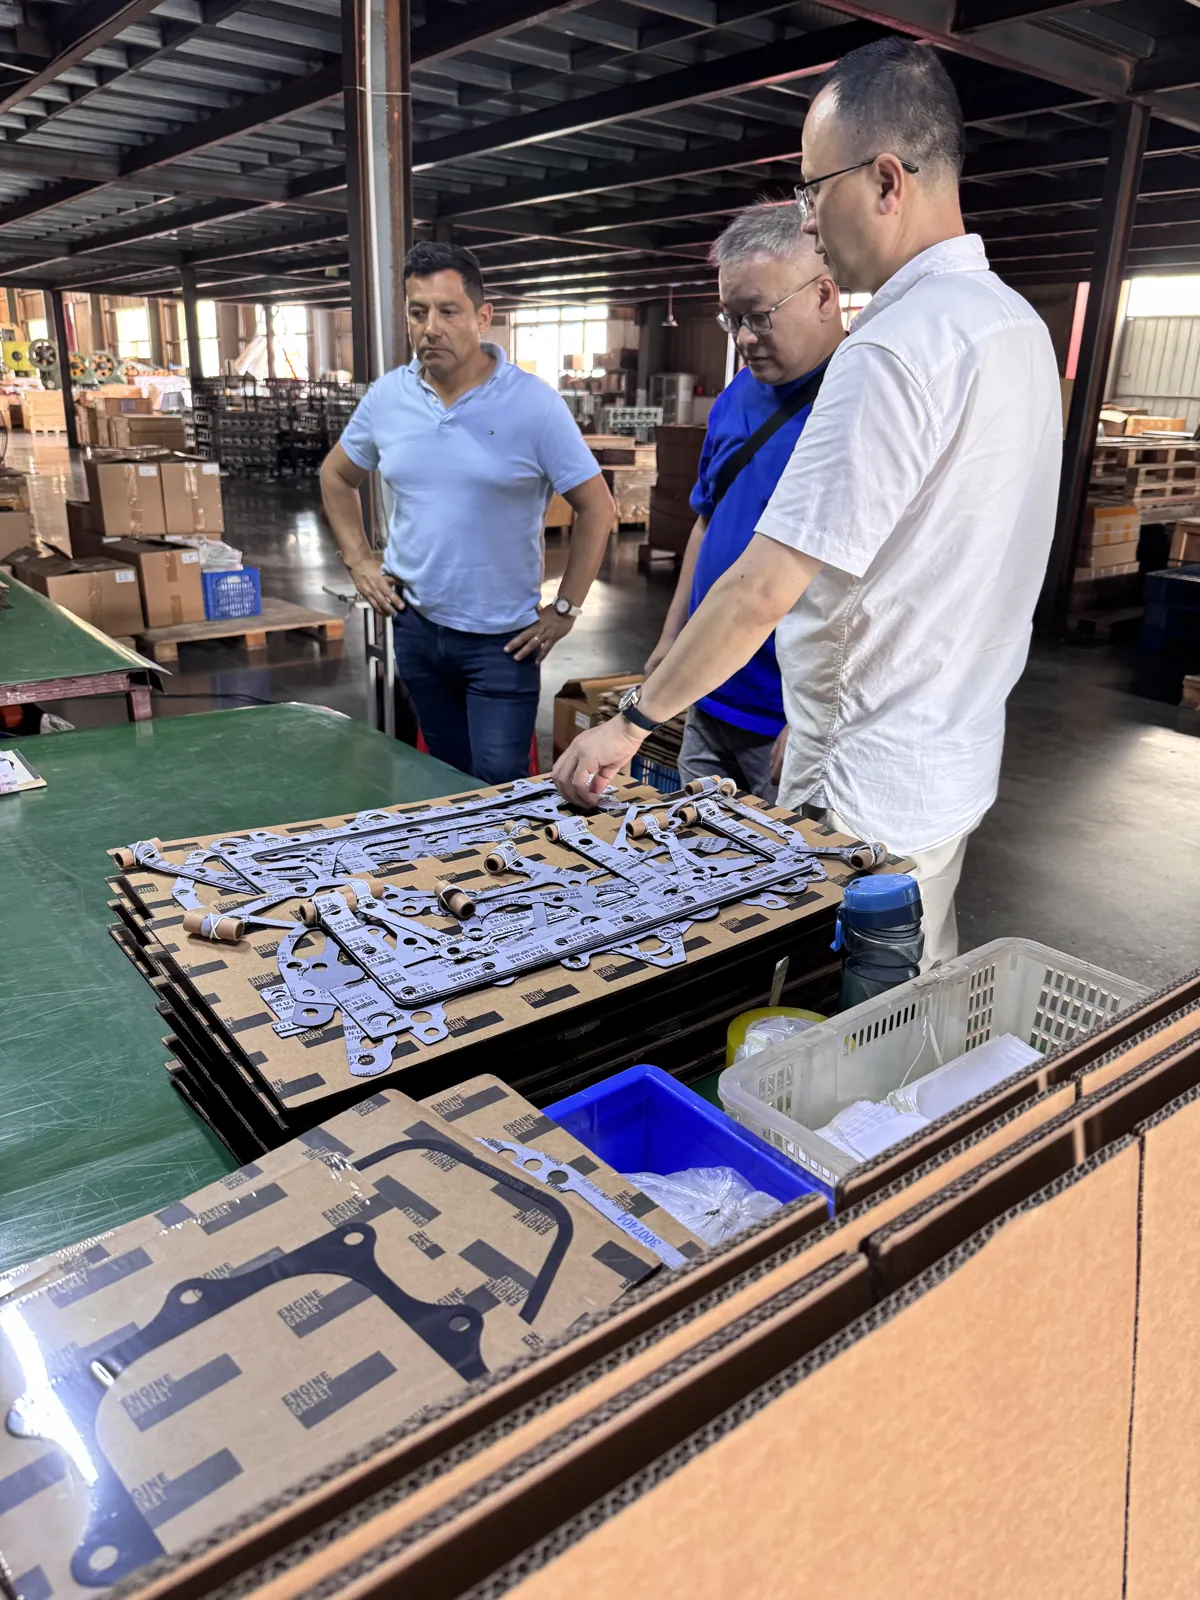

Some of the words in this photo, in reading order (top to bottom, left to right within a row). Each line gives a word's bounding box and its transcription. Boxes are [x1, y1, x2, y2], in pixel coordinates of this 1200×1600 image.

[430, 1093, 465, 1112] ENGINE
[436, 1101, 465, 1117] GASKET
[502, 1113, 536, 1131] ENGINE
[508, 1121, 539, 1137] GASKET
[321, 1194, 364, 1219] ENGINE
[528, 1208, 558, 1229] GASKET
[513, 1210, 550, 1236] ENGINE
[616, 1212, 662, 1249] 3007404
[277, 1289, 324, 1318] ENGINE
[484, 1278, 520, 1307] ENGINE
[284, 1301, 325, 1327] GASKET
[120, 1372, 176, 1407] ENGINE
[281, 1370, 333, 1407] ENGINE
[289, 1384, 333, 1416] GASKET
